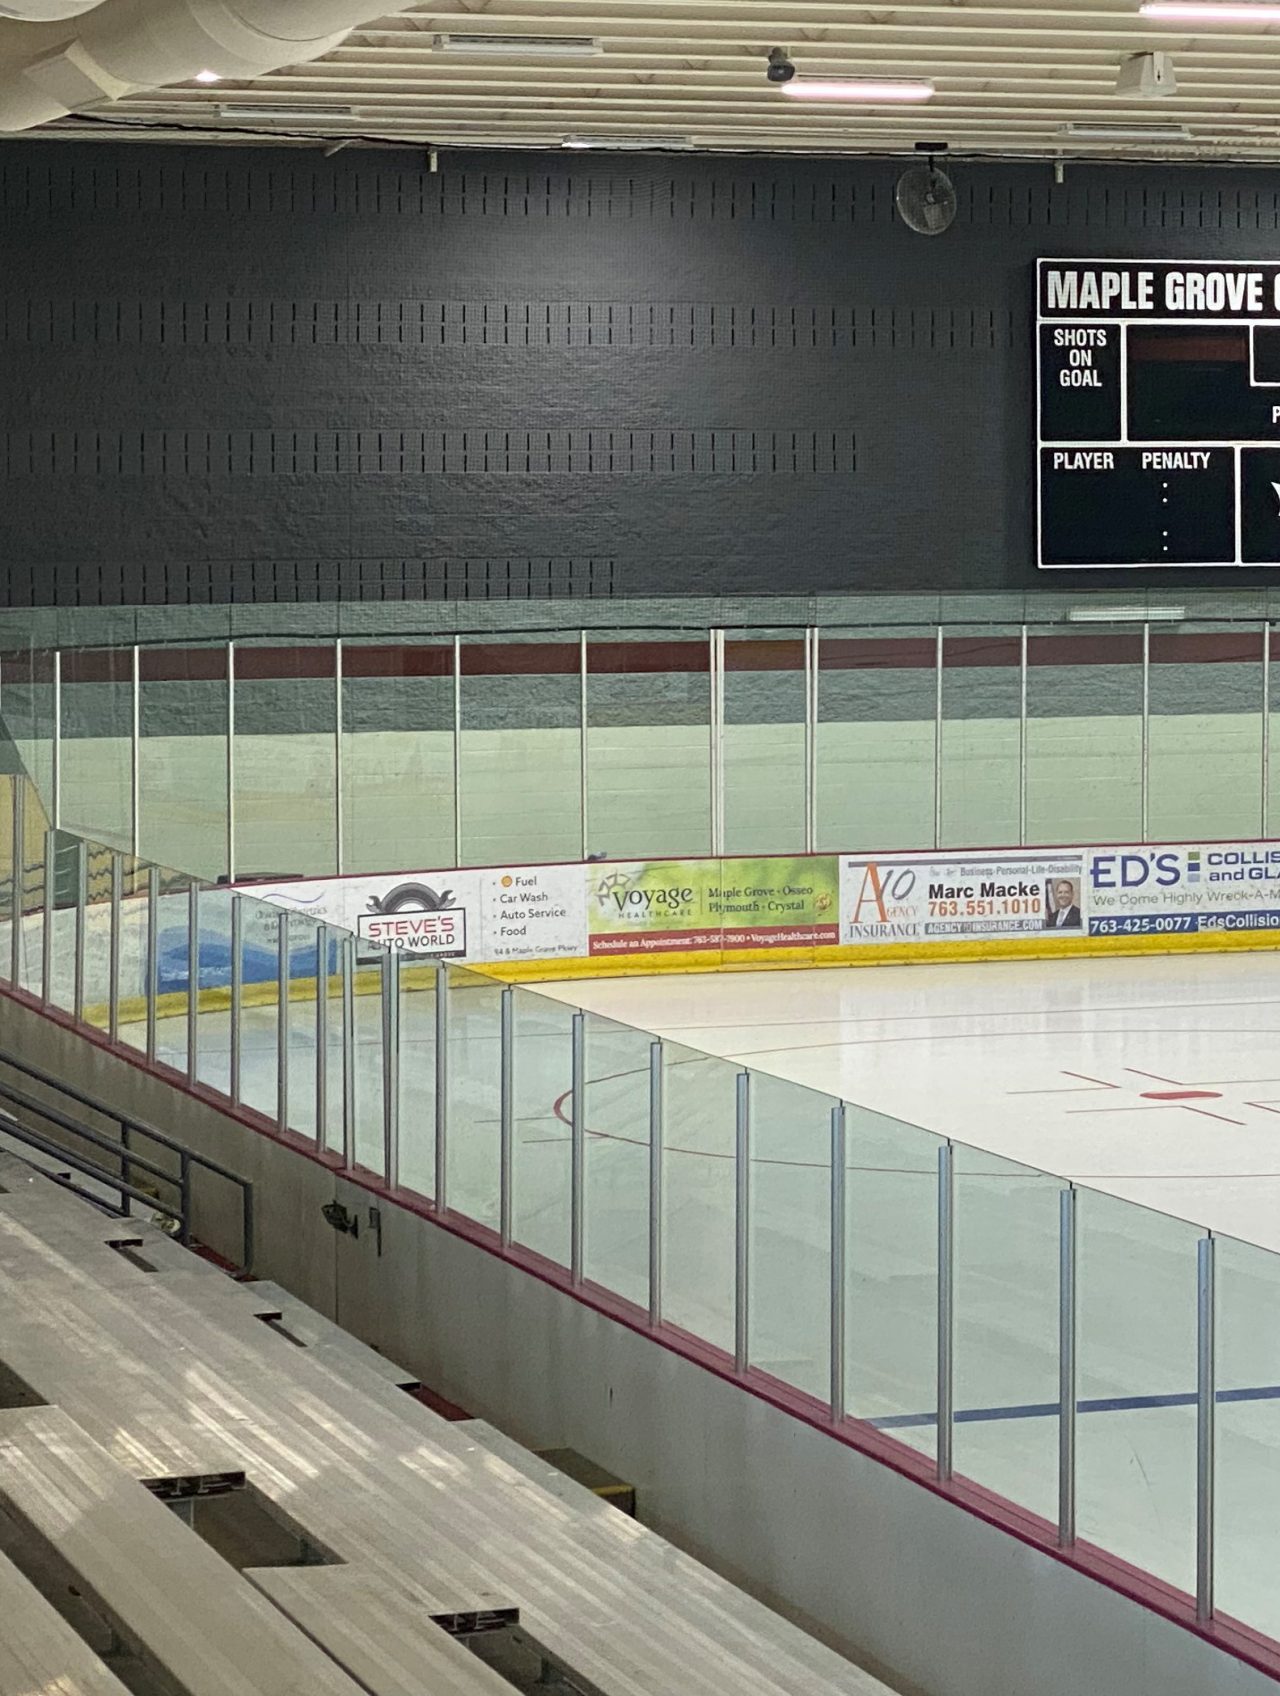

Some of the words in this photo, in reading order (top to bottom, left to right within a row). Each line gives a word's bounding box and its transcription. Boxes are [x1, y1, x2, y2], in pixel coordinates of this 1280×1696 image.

[1046, 270, 1154, 310] MAPLE
[1165, 272, 1263, 312] GROVE
[1053, 328, 1107, 348] SHOTS
[1069, 349, 1092, 368] ON
[1059, 368, 1102, 388] GOAL
[1053, 452, 1115, 470] PLAYER
[1142, 451, 1210, 470] PENALTY
[1090, 853, 1181, 888] ED'S
[1209, 867, 1244, 882] and
[515, 876, 537, 887] Fuel
[500, 893, 517, 904] Car
[520, 892, 548, 903] Wash
[613, 886, 693, 912] Voyage
[708, 887, 742, 899] Maple
[744, 886, 775, 897] Grove
[783, 885, 814, 896] Osseo
[928, 883, 974, 900] Marc
[980, 881, 1040, 898] Macke
[1093, 895, 1115, 906] We
[1119, 893, 1159, 906] Come
[1163, 891, 1203, 906] Highly
[500, 910, 526, 920] Auto
[528, 907, 566, 919] Service
[618, 909, 692, 920] HEALTHCARE
[708, 902, 760, 915] Plymouth
[767, 900, 805, 914] Crystal
[928, 898, 1041, 917] 763.551.1010
[368, 916, 455, 937] STEVE'S
[500, 925, 527, 936] Food
[849, 922, 920, 938] INSURANCE
[1090, 916, 1190, 934] 763-425-0077
[408, 934, 455, 947] WORLD
